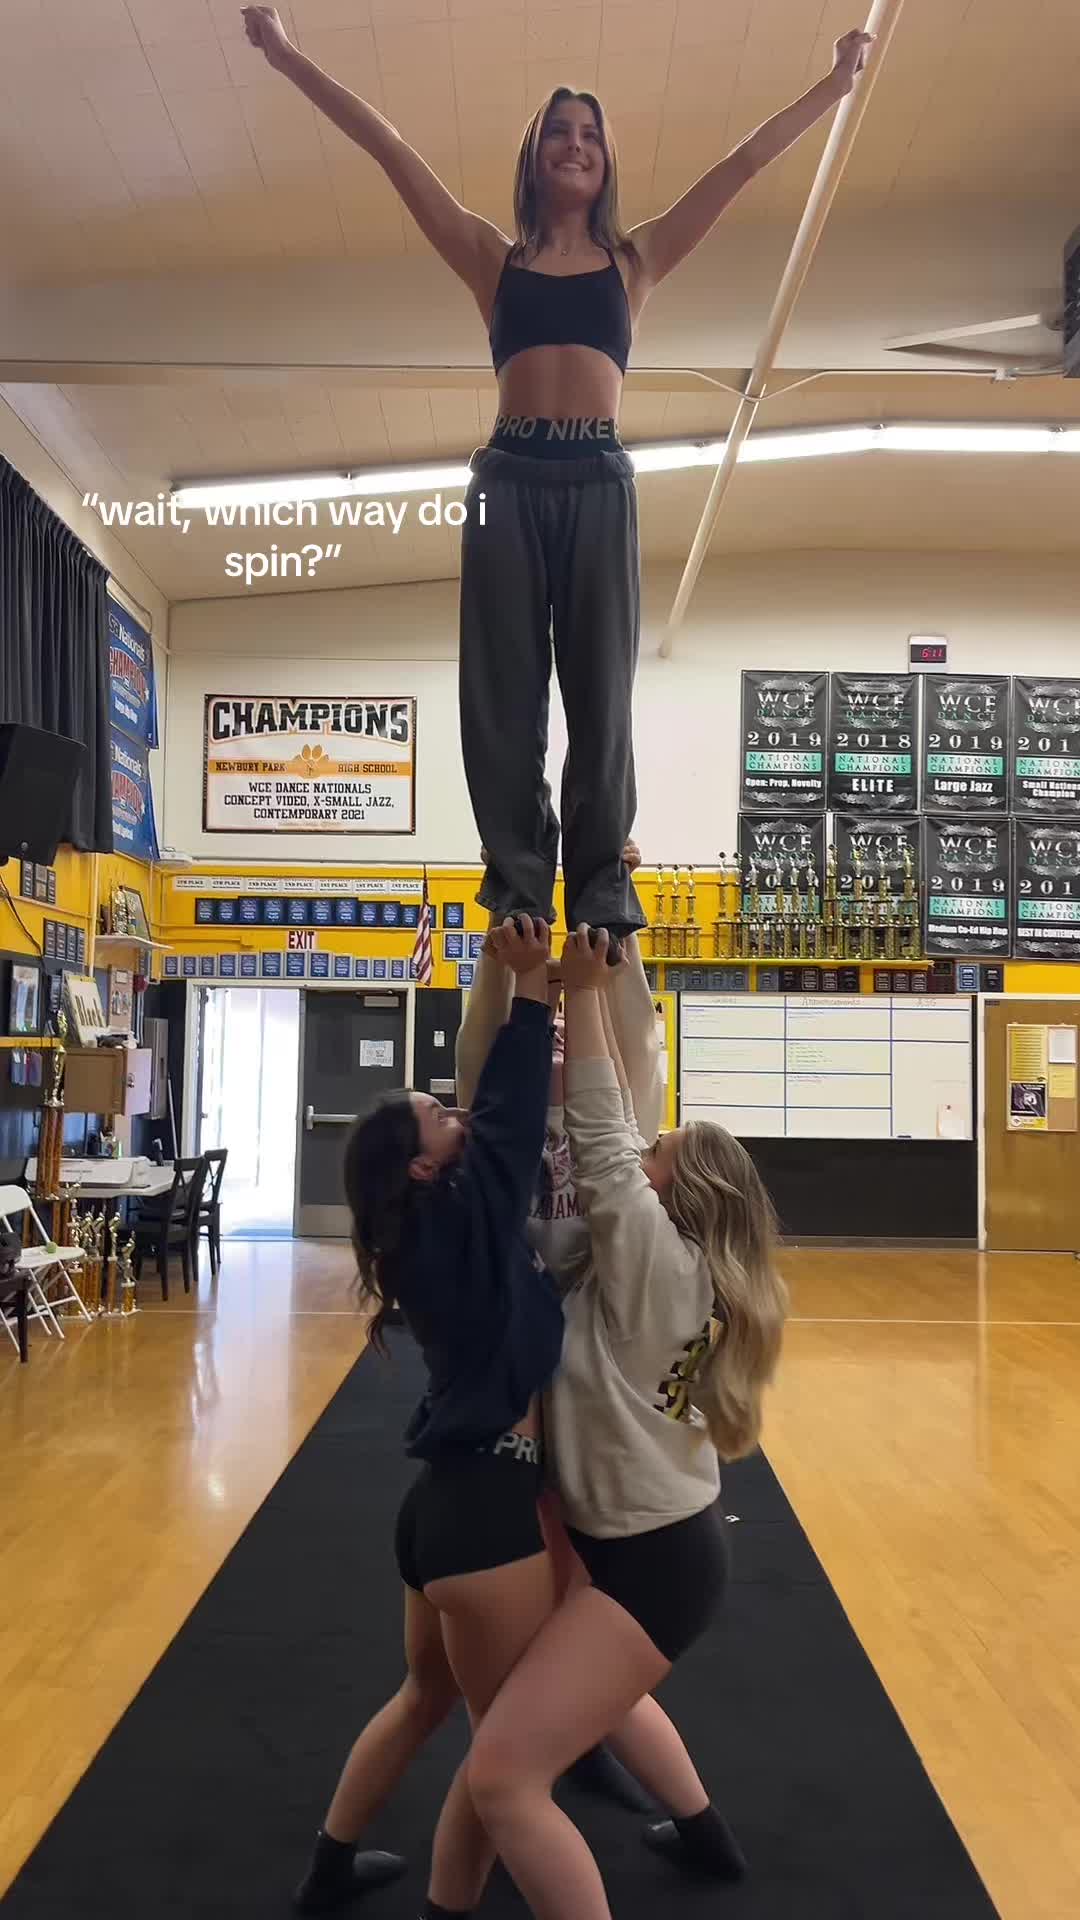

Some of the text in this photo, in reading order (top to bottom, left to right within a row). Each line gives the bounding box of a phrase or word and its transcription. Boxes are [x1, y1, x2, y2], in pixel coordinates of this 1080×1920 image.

[496, 416, 610, 440] PRO NIKE
[758, 692, 814, 709] WCE
[848, 693, 904, 711] WCE
[939, 695, 996, 713] WCE
[757, 709, 815, 718] DANCE
[846, 711, 904, 719] DANCE
[938, 712, 995, 721] DANCE
[1027, 715, 1077, 723] DANC
[212, 702, 409, 743] CHAMPIONS
[747, 731, 821, 746] 2019
[837, 733, 911, 748] 2018
[928, 733, 1003, 749] 2019
[1017, 737, 1070, 752] 201
[750, 754, 817, 762] NATIONAL
[839, 755, 906, 763] NATIONAL
[930, 756, 997, 765] NATIONAL
[1020, 760, 1080, 768] NATIONA
[216, 762, 397, 773] NEWBURY PARK HIGH SCHOOL
[750, 762, 817, 770] CHAMPIONS
[839, 763, 906, 771] CHAMPIONS
[930, 765, 998, 774] CHAMPIONS
[1020, 768, 1080, 777] CHAMPION
[249, 782, 371, 794] WCE DANCE NATIONALS
[852, 779, 894, 792] ELITE
[934, 779, 993, 792] Large Jazz
[224, 795, 394, 808] CONCEPT VIDEO, X-SMALL JAZZ,
[254, 808, 365, 820] CONTEMPORARY 2021
[754, 834, 812, 851] WCE
[939, 837, 997, 855] WCE
[1028, 857, 1077, 865] DANC
[931, 876, 1005, 892] 2019
[1019, 880, 1073, 895] 201
[933, 898, 1000, 908] NATIONAL
[933, 907, 1000, 916] CHAMPIONS
[1021, 911, 1080, 919] CHAMPION
[288, 931, 315, 949] EXIT
